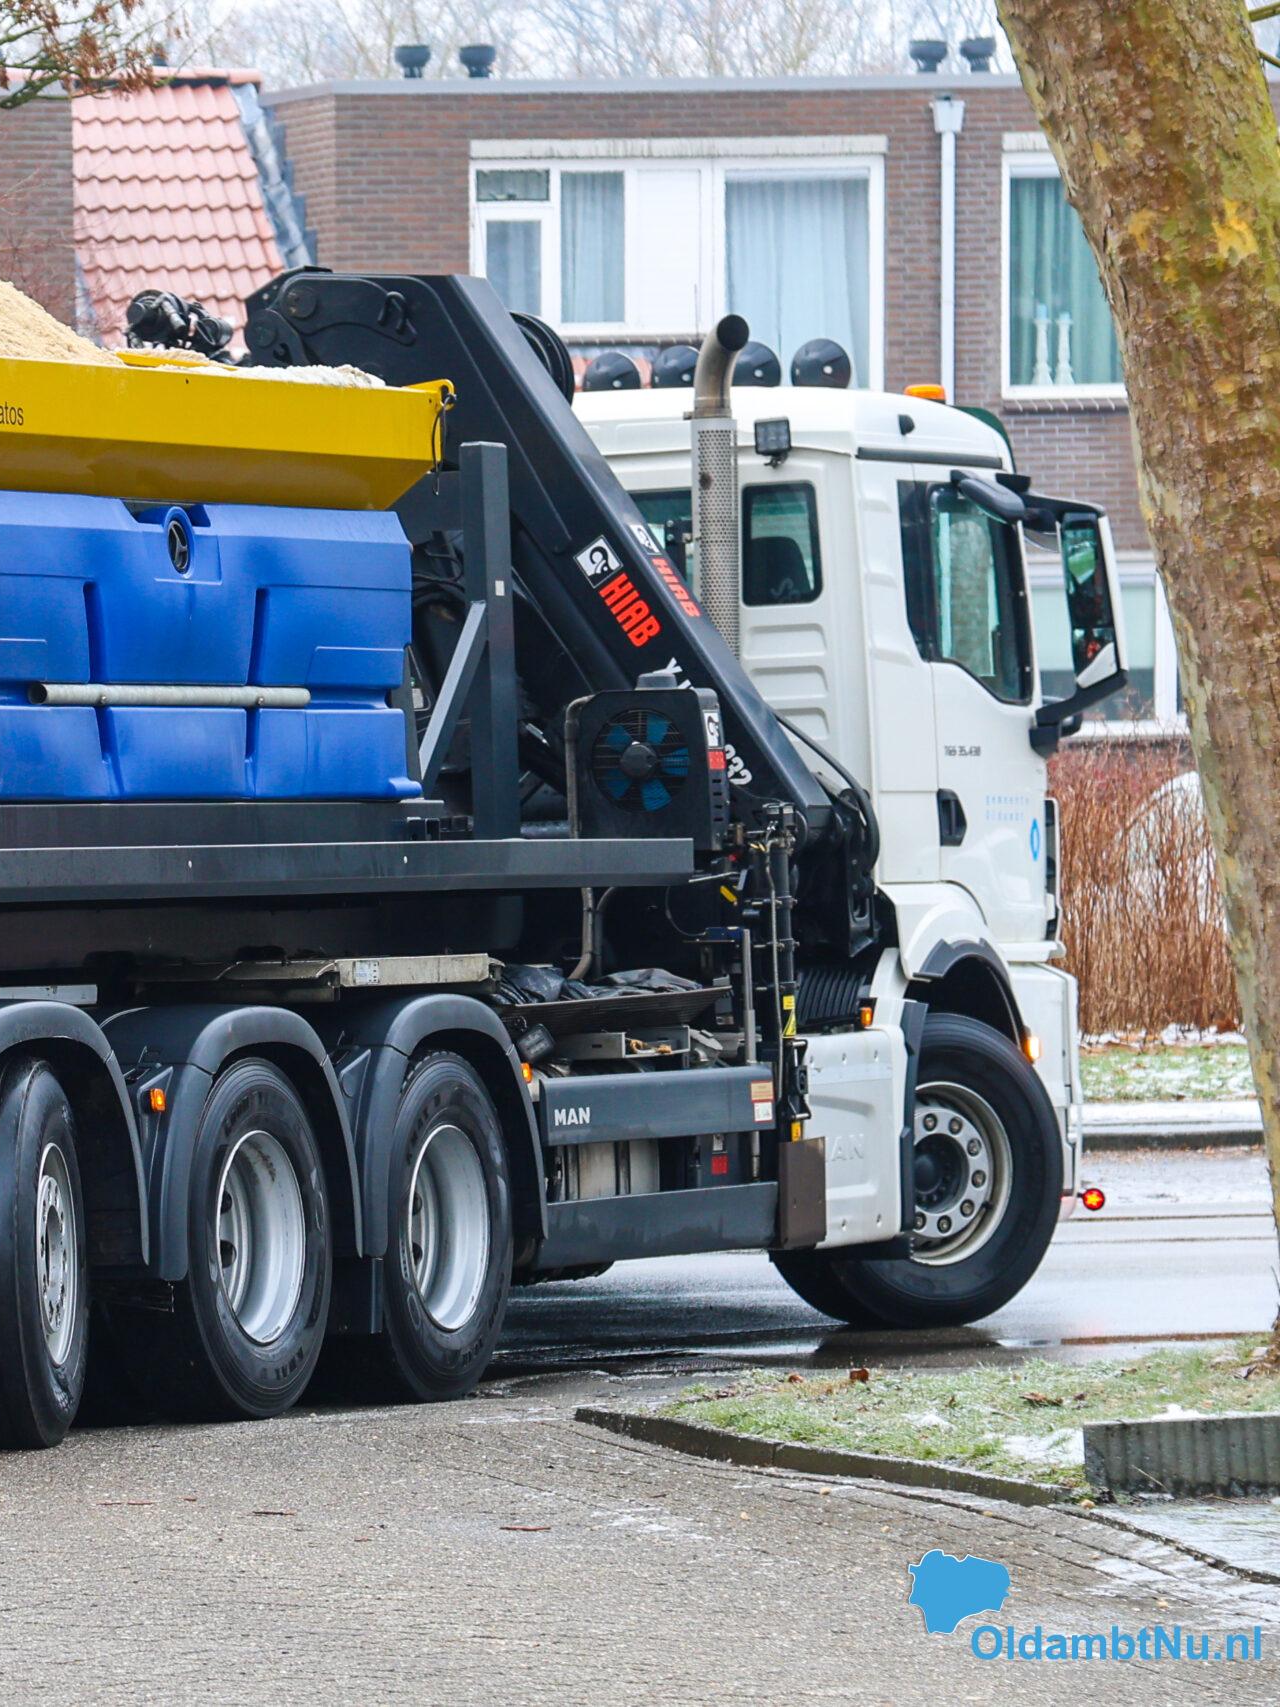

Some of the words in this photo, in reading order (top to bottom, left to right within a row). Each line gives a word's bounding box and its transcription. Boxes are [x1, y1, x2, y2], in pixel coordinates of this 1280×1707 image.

[598, 572, 662, 648] HIAB
[651, 557, 701, 617] HIAB
[553, 1106, 591, 1127] MAN
